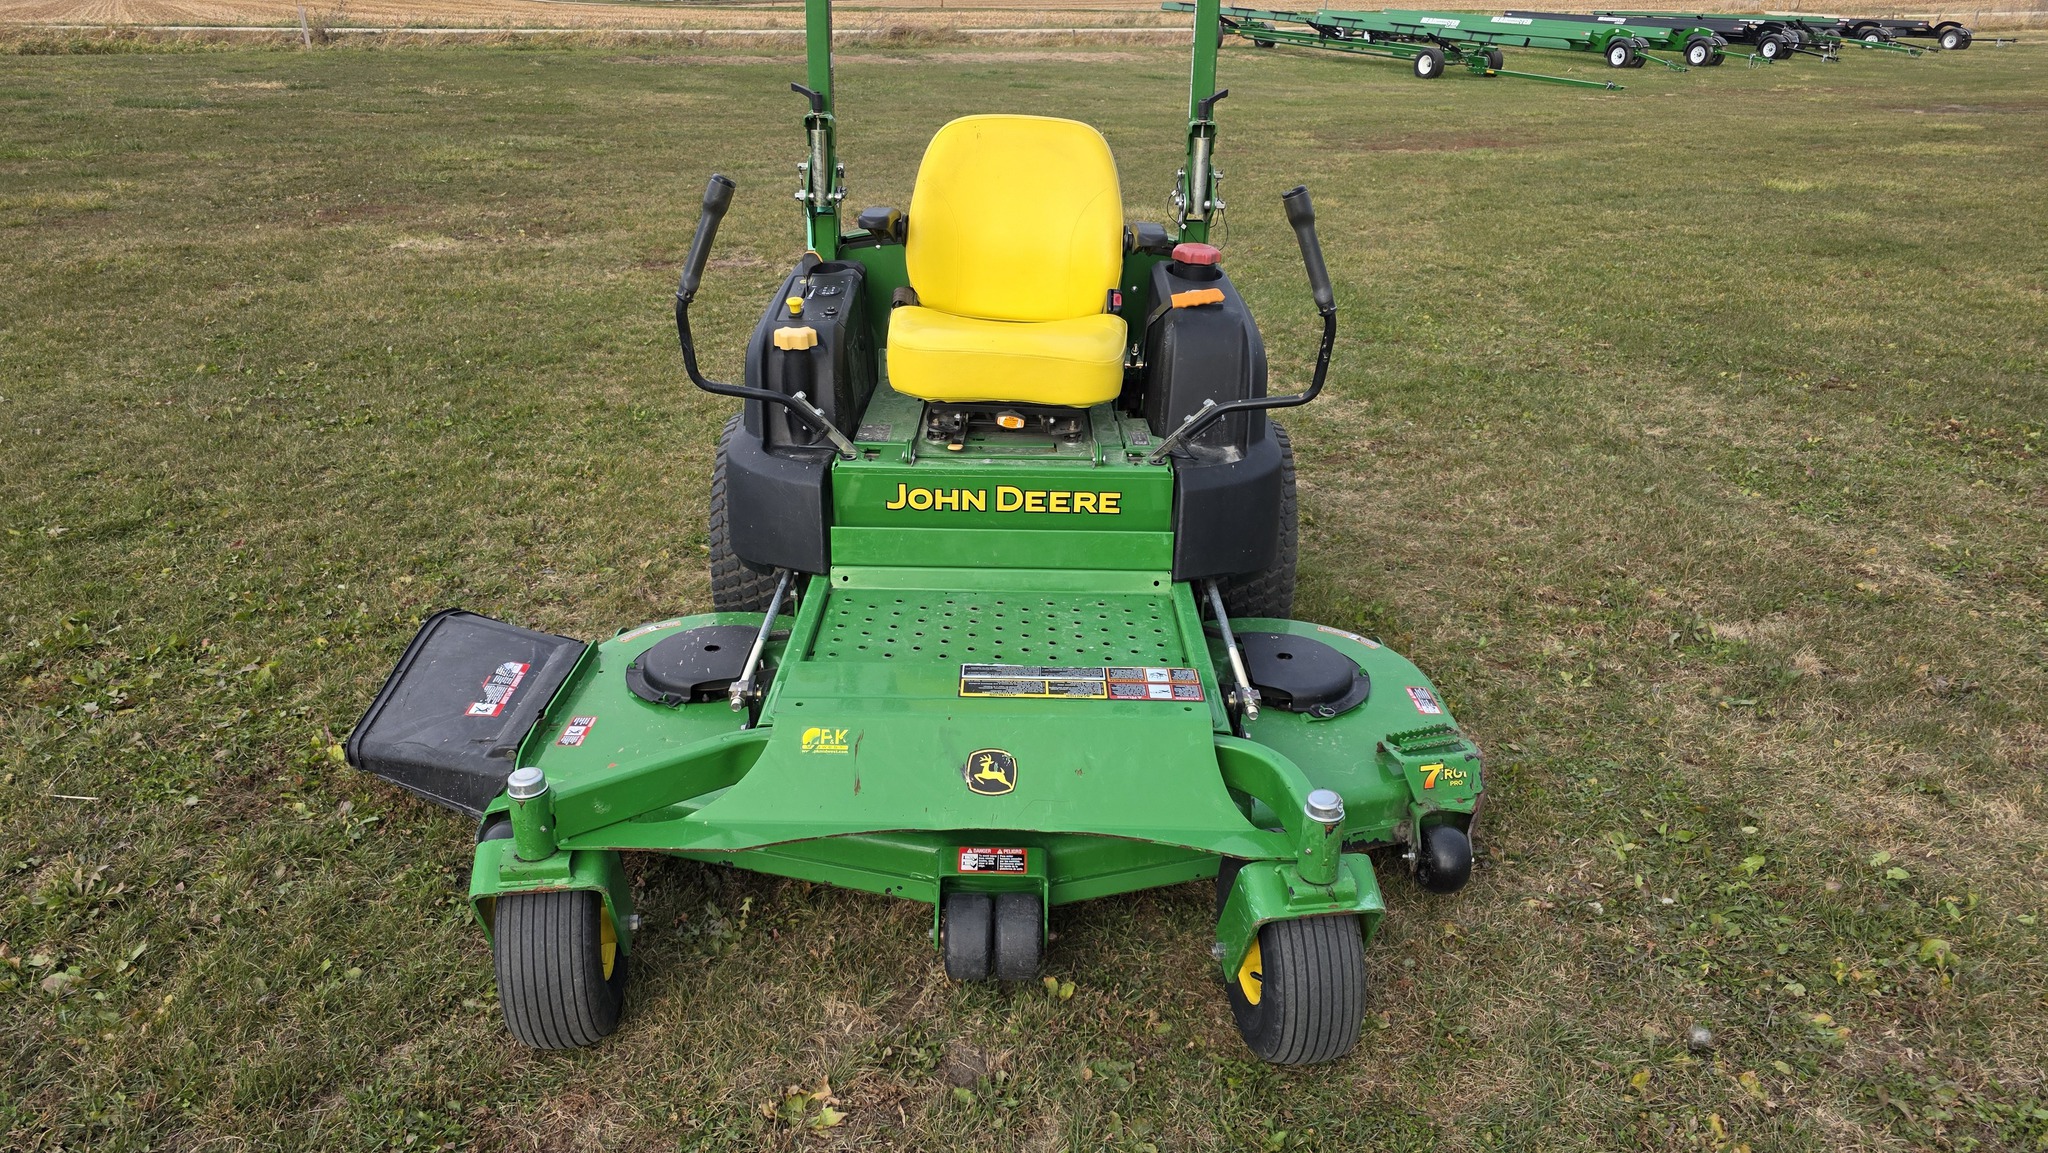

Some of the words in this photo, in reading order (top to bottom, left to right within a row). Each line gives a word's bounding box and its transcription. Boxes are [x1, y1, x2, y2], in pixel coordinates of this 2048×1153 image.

[886, 483, 987, 512] JOHN
[995, 484, 1122, 514] DEERE
[1420, 763, 1444, 789] 7
